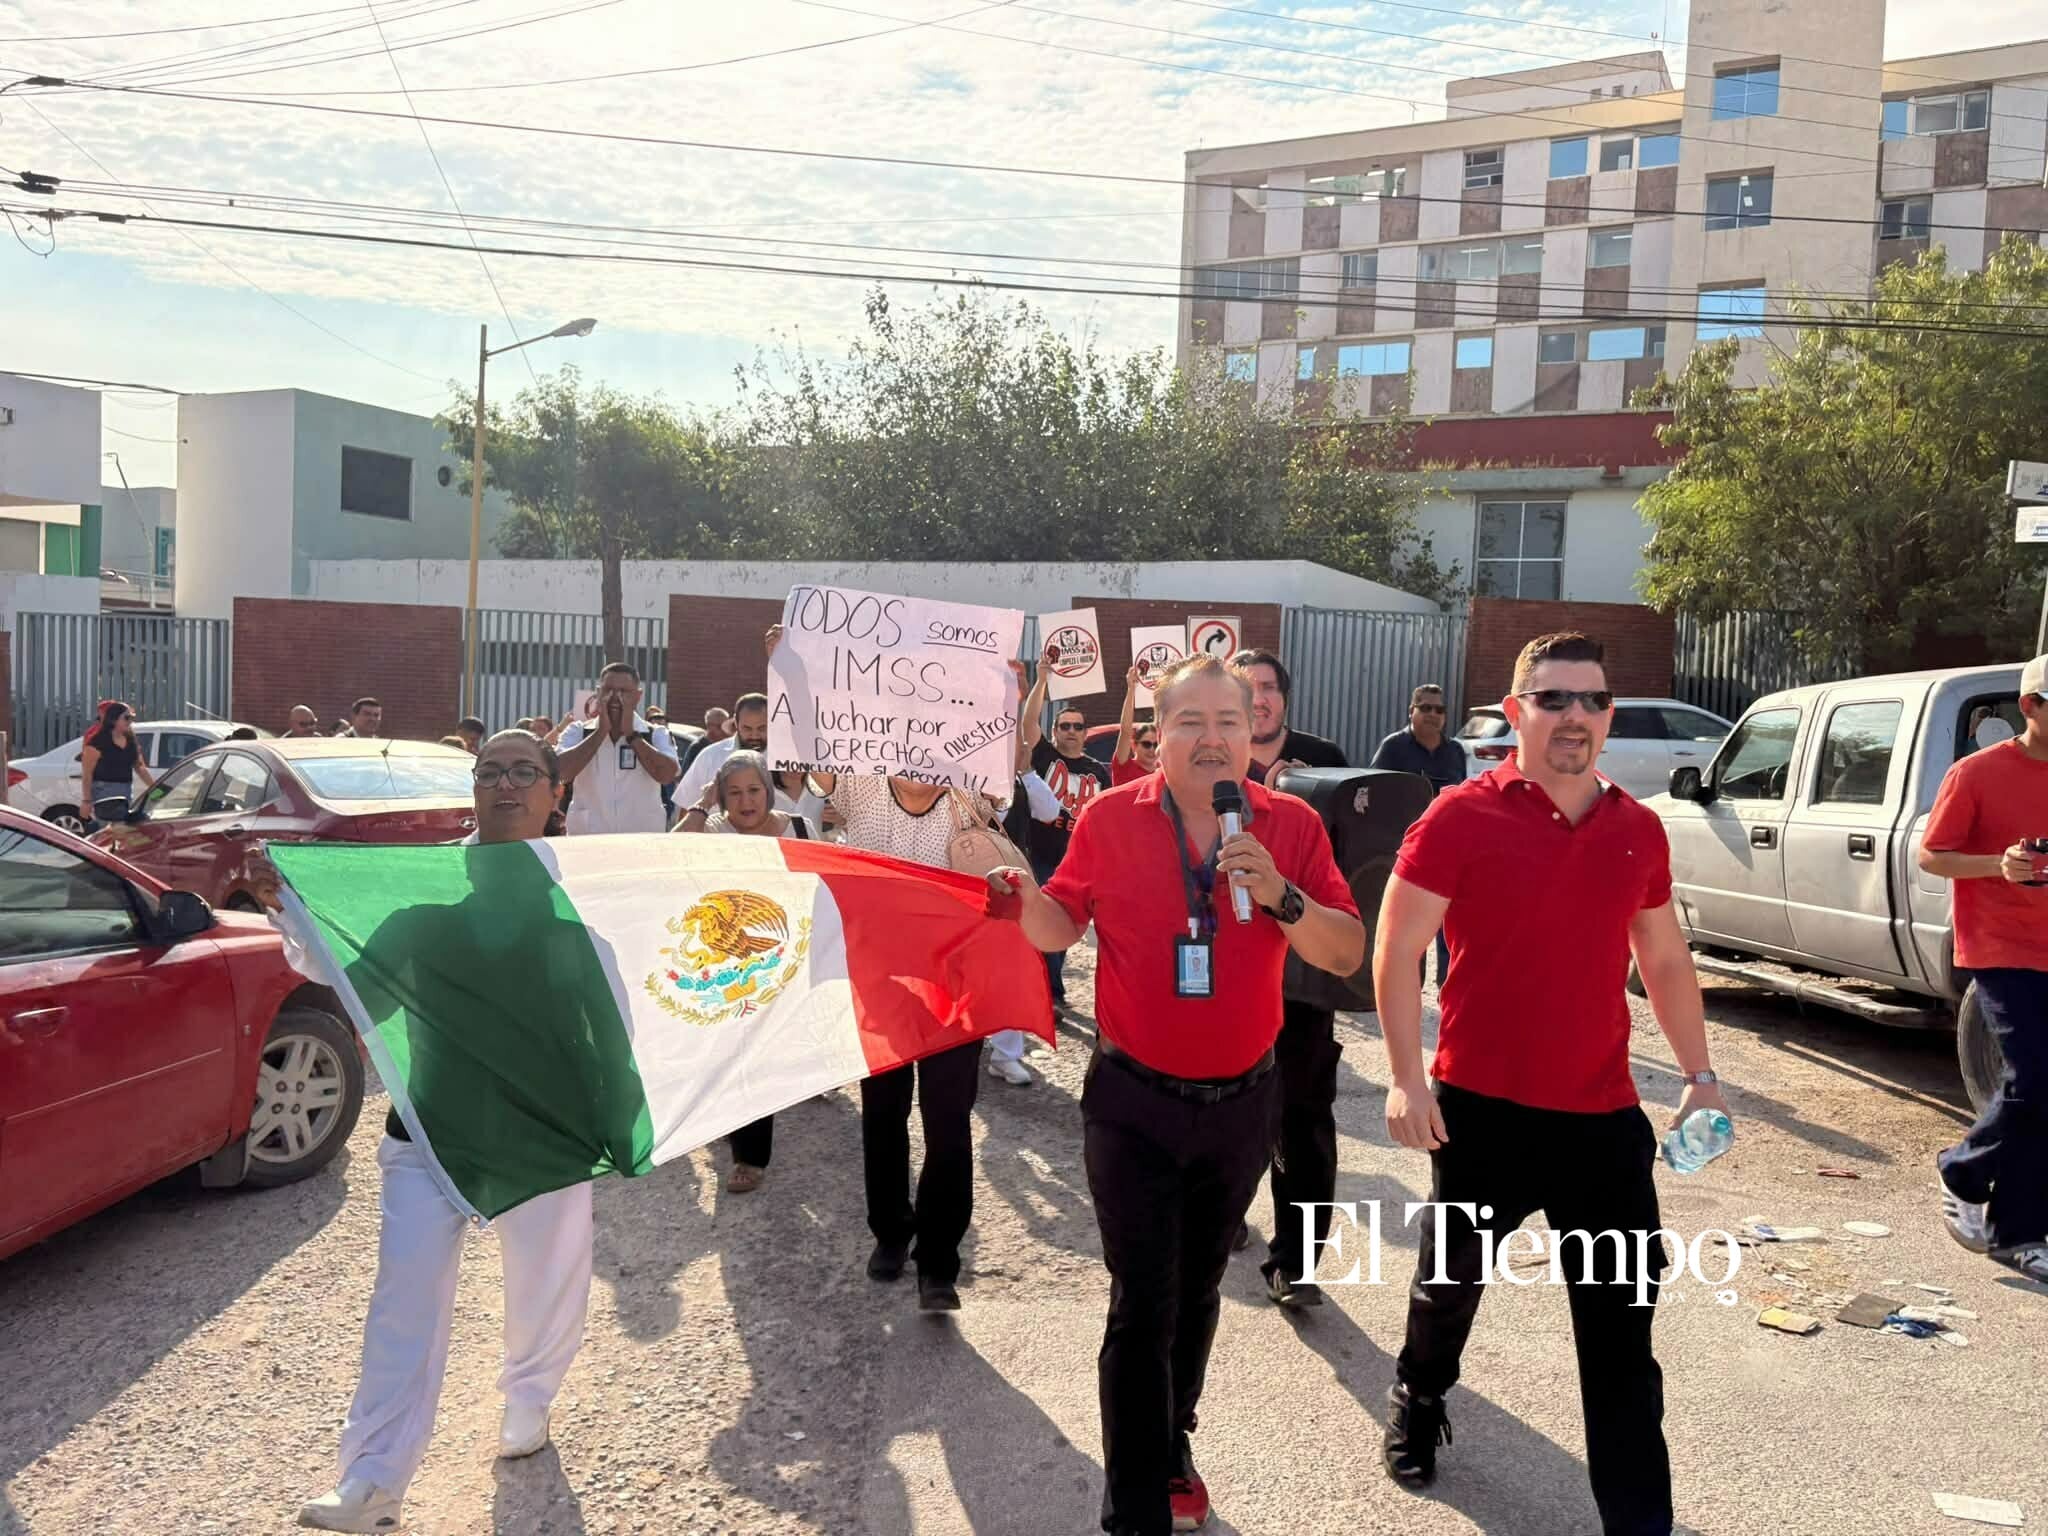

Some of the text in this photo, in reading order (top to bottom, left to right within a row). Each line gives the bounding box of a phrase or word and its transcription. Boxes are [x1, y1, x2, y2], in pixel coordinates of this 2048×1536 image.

[789, 587, 999, 649] TODOS somos
[771, 692, 1017, 758] A luchar por nuestros
[775, 759, 855, 774] MONCLOVA
[894, 769, 954, 787] APOYA
[815, 737, 935, 769] DERECHOS
